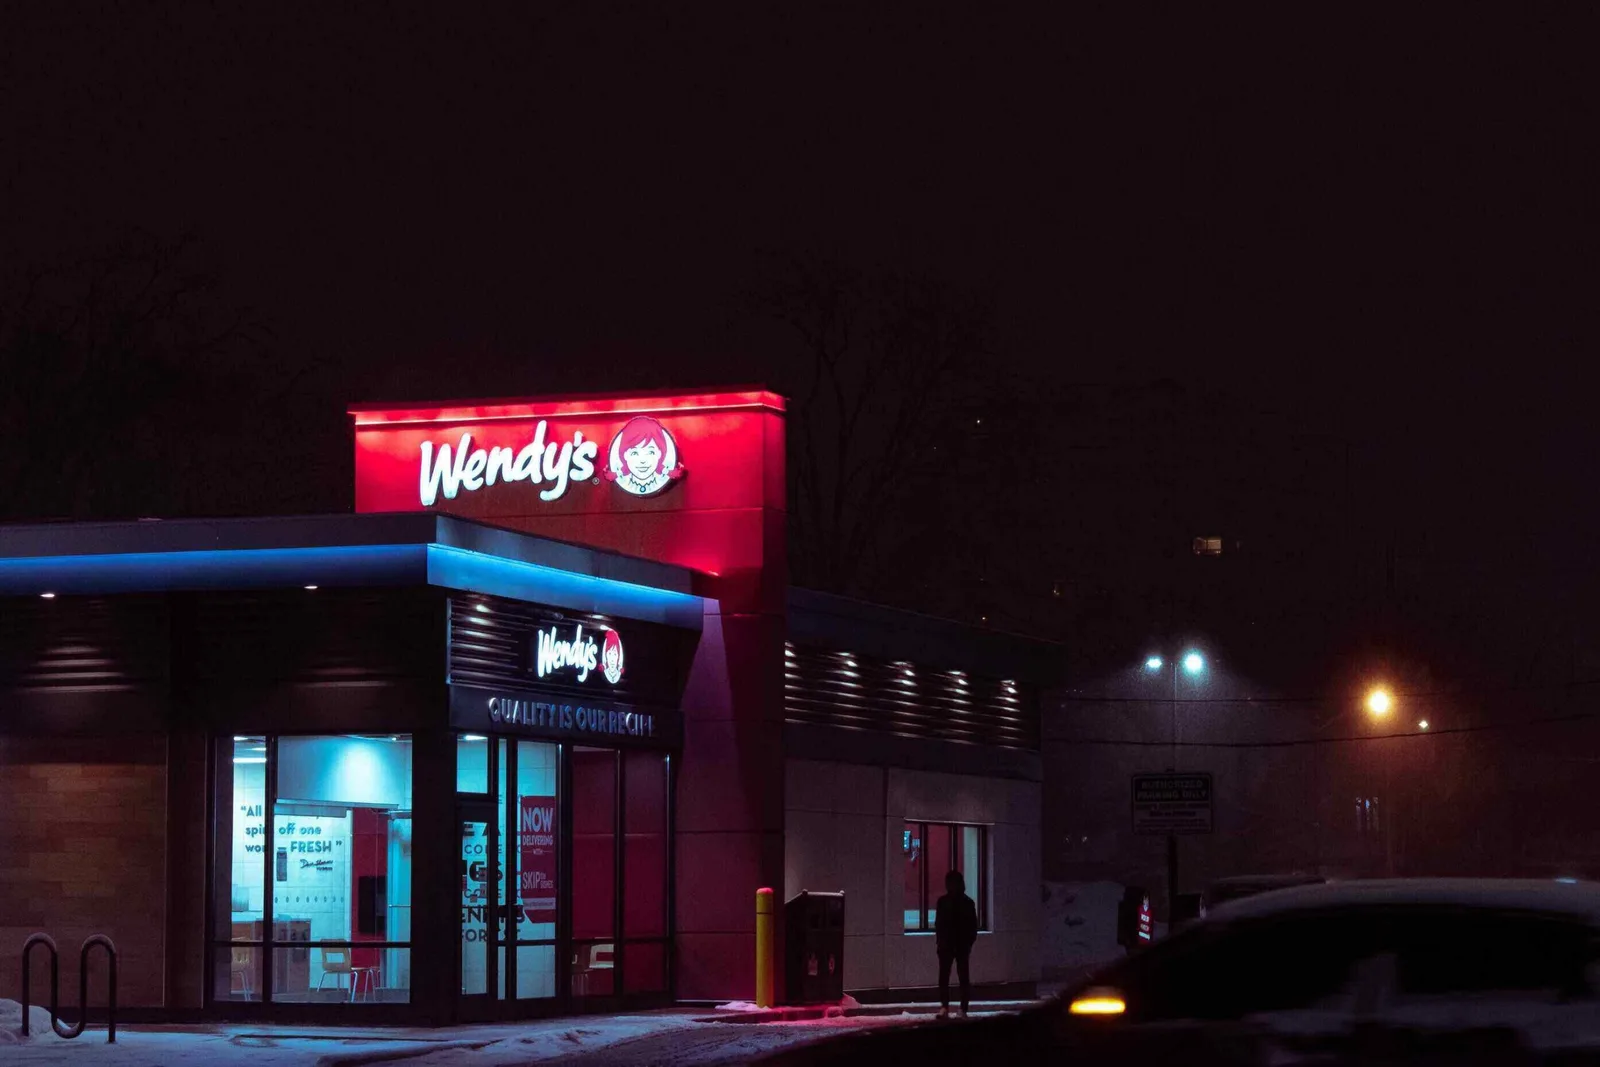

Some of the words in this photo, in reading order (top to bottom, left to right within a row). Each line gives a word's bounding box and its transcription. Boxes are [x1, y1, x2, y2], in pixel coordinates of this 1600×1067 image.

[420, 420, 598, 506] Wendy's
[537, 624, 598, 683] Wendy's
[488, 697, 556, 728] QUALITY
[558, 704, 574, 729] IS
[576, 706, 607, 733] OUR
[300, 826, 321, 835] one
[522, 807, 554, 833] NOW
[522, 871, 541, 890] SKIP
